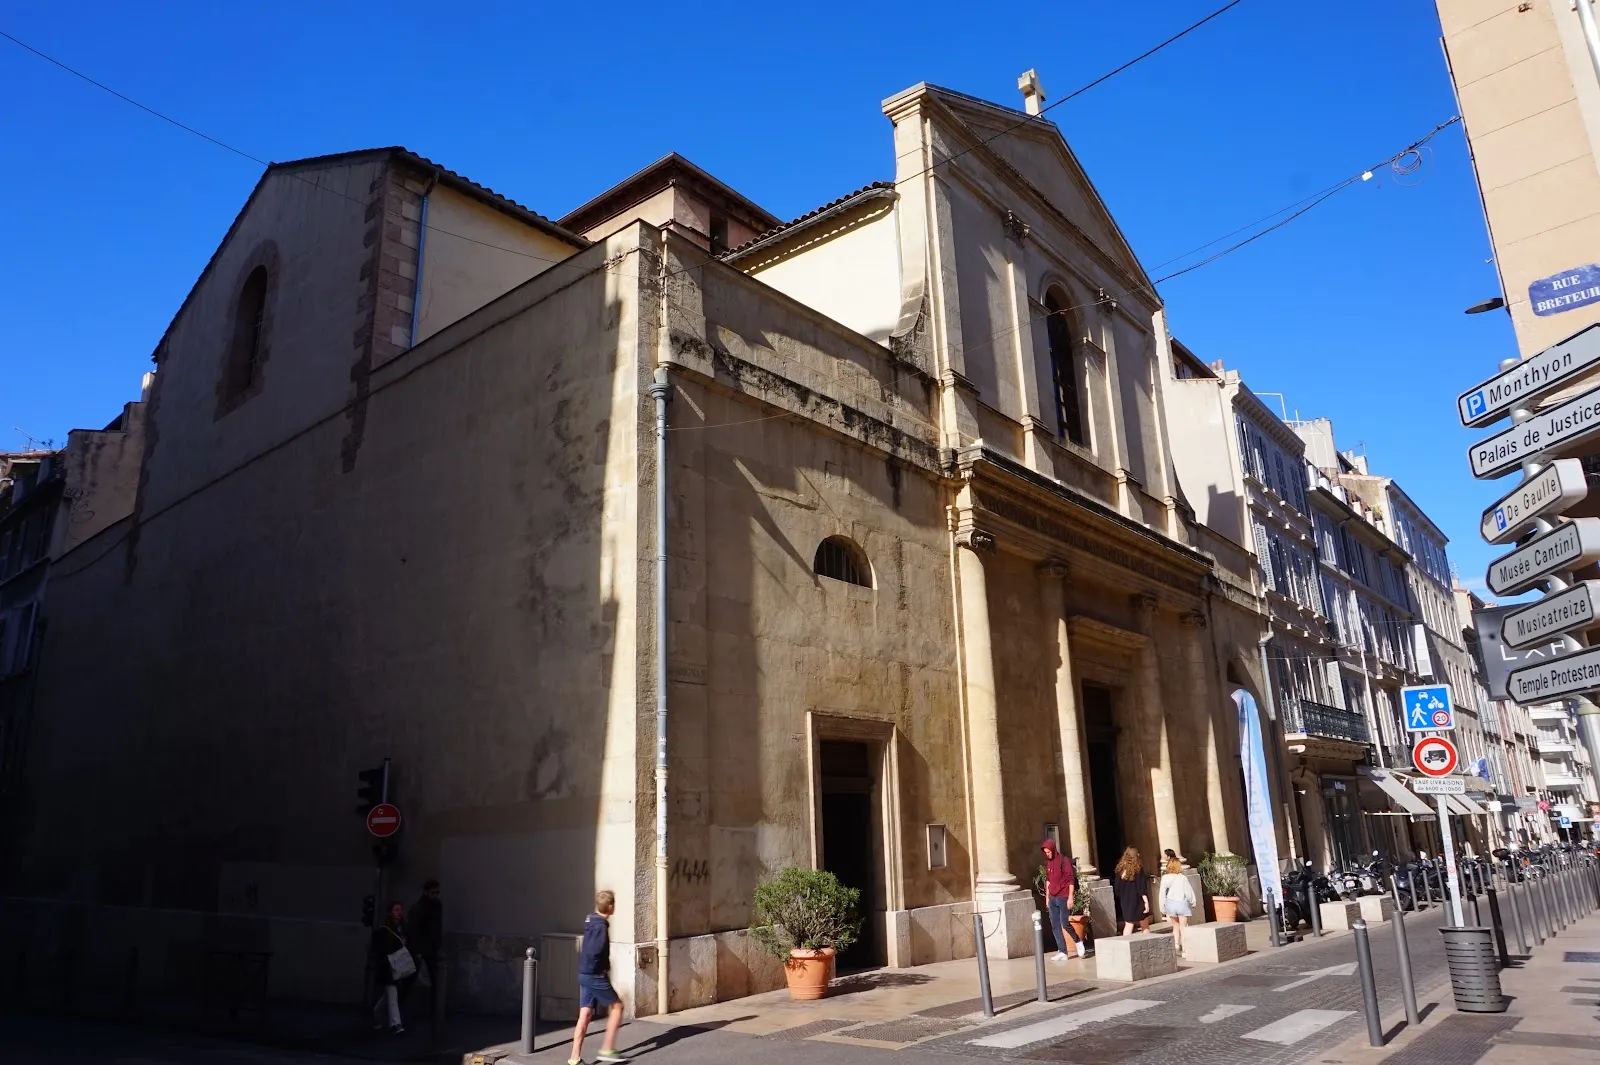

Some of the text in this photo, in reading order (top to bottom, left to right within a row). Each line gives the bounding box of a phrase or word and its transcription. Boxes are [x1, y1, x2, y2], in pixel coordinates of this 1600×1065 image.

[1552, 274, 1580, 291] RUE
[1489, 351, 1573, 405] Monthyon
[1479, 402, 1600, 468] Palais de Justice
[1506, 502, 1519, 523] De
[1523, 477, 1557, 505] Gaulle
[1500, 533, 1575, 584] Musée Cantini
[1517, 598, 1587, 637] Musicatreize
[1517, 674, 1549, 695] Temple
